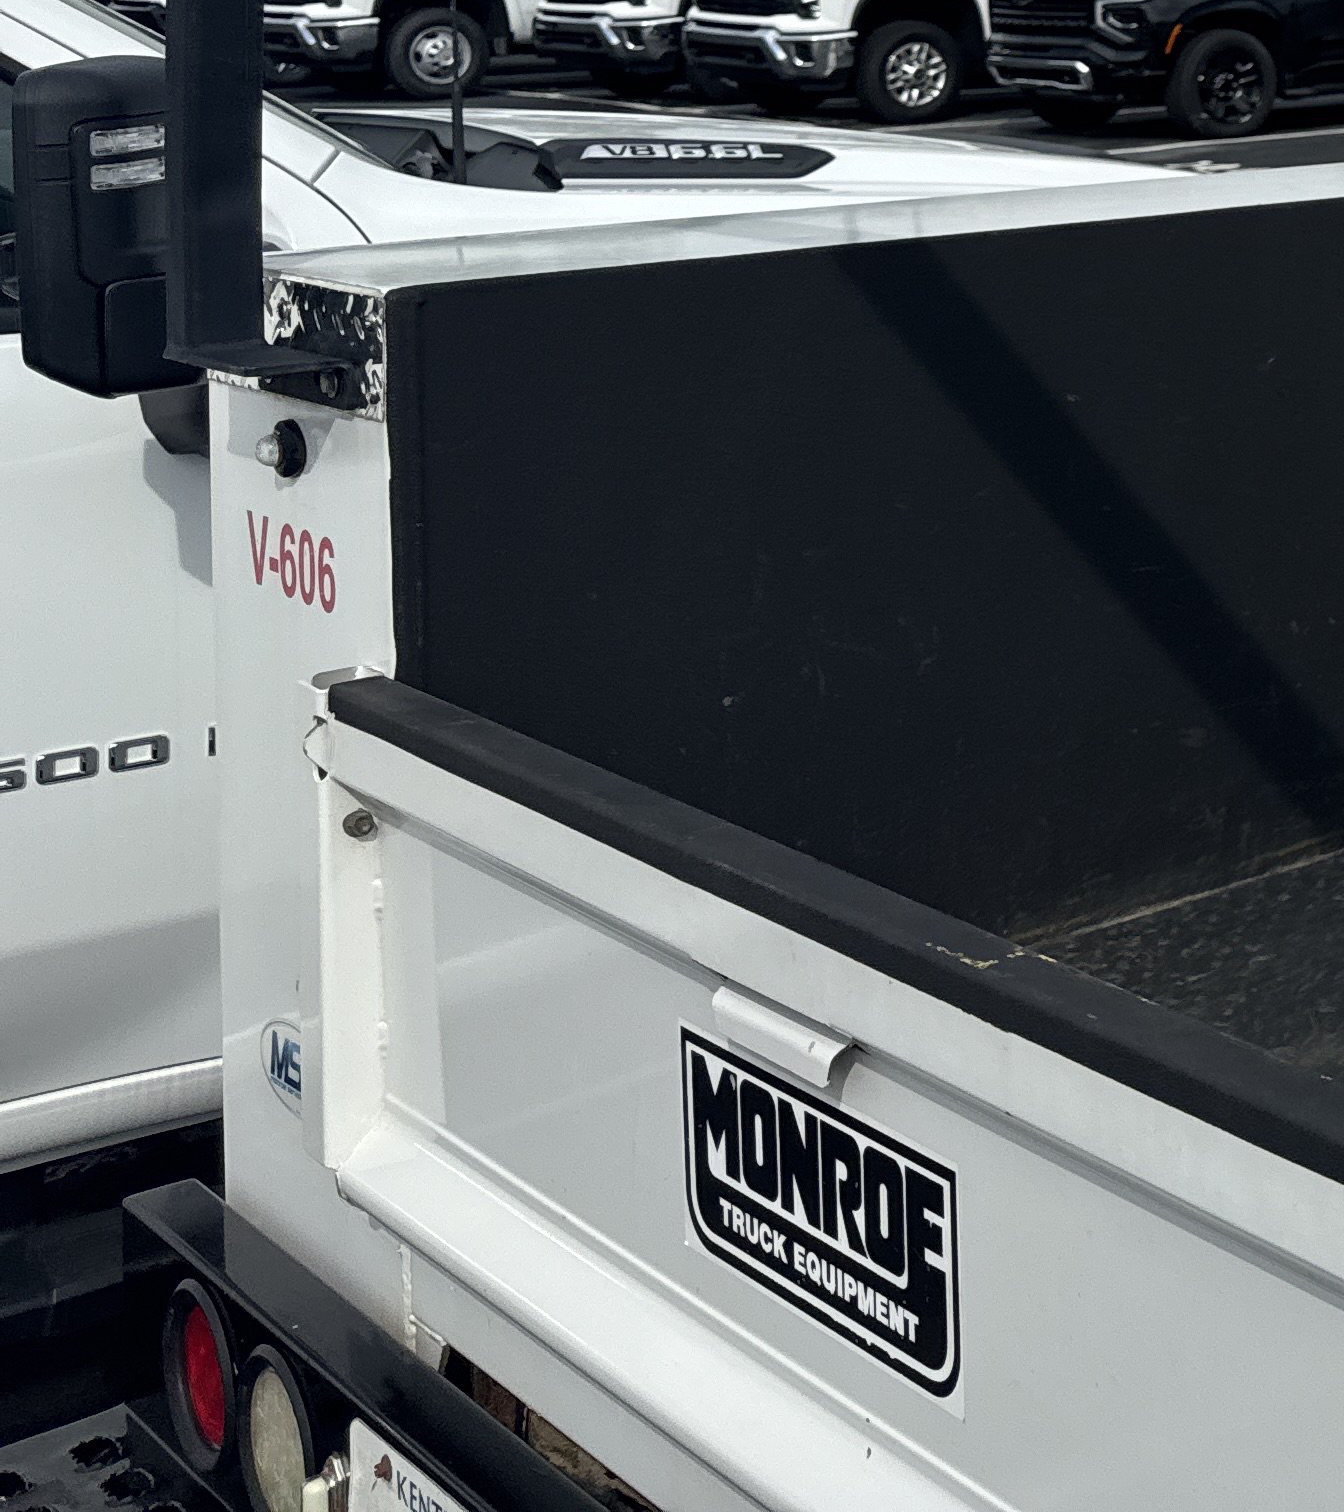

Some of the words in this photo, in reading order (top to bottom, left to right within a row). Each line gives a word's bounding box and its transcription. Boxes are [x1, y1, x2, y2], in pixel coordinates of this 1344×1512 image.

[602, 144, 656, 157] V8
[669, 143, 783, 159] 6.6L
[246, 509, 337, 614] V-606
[691, 1049, 948, 1300] MONROE
[718, 1195, 789, 1265] TRUCK
[792, 1244, 920, 1344] EQUIPMENT
